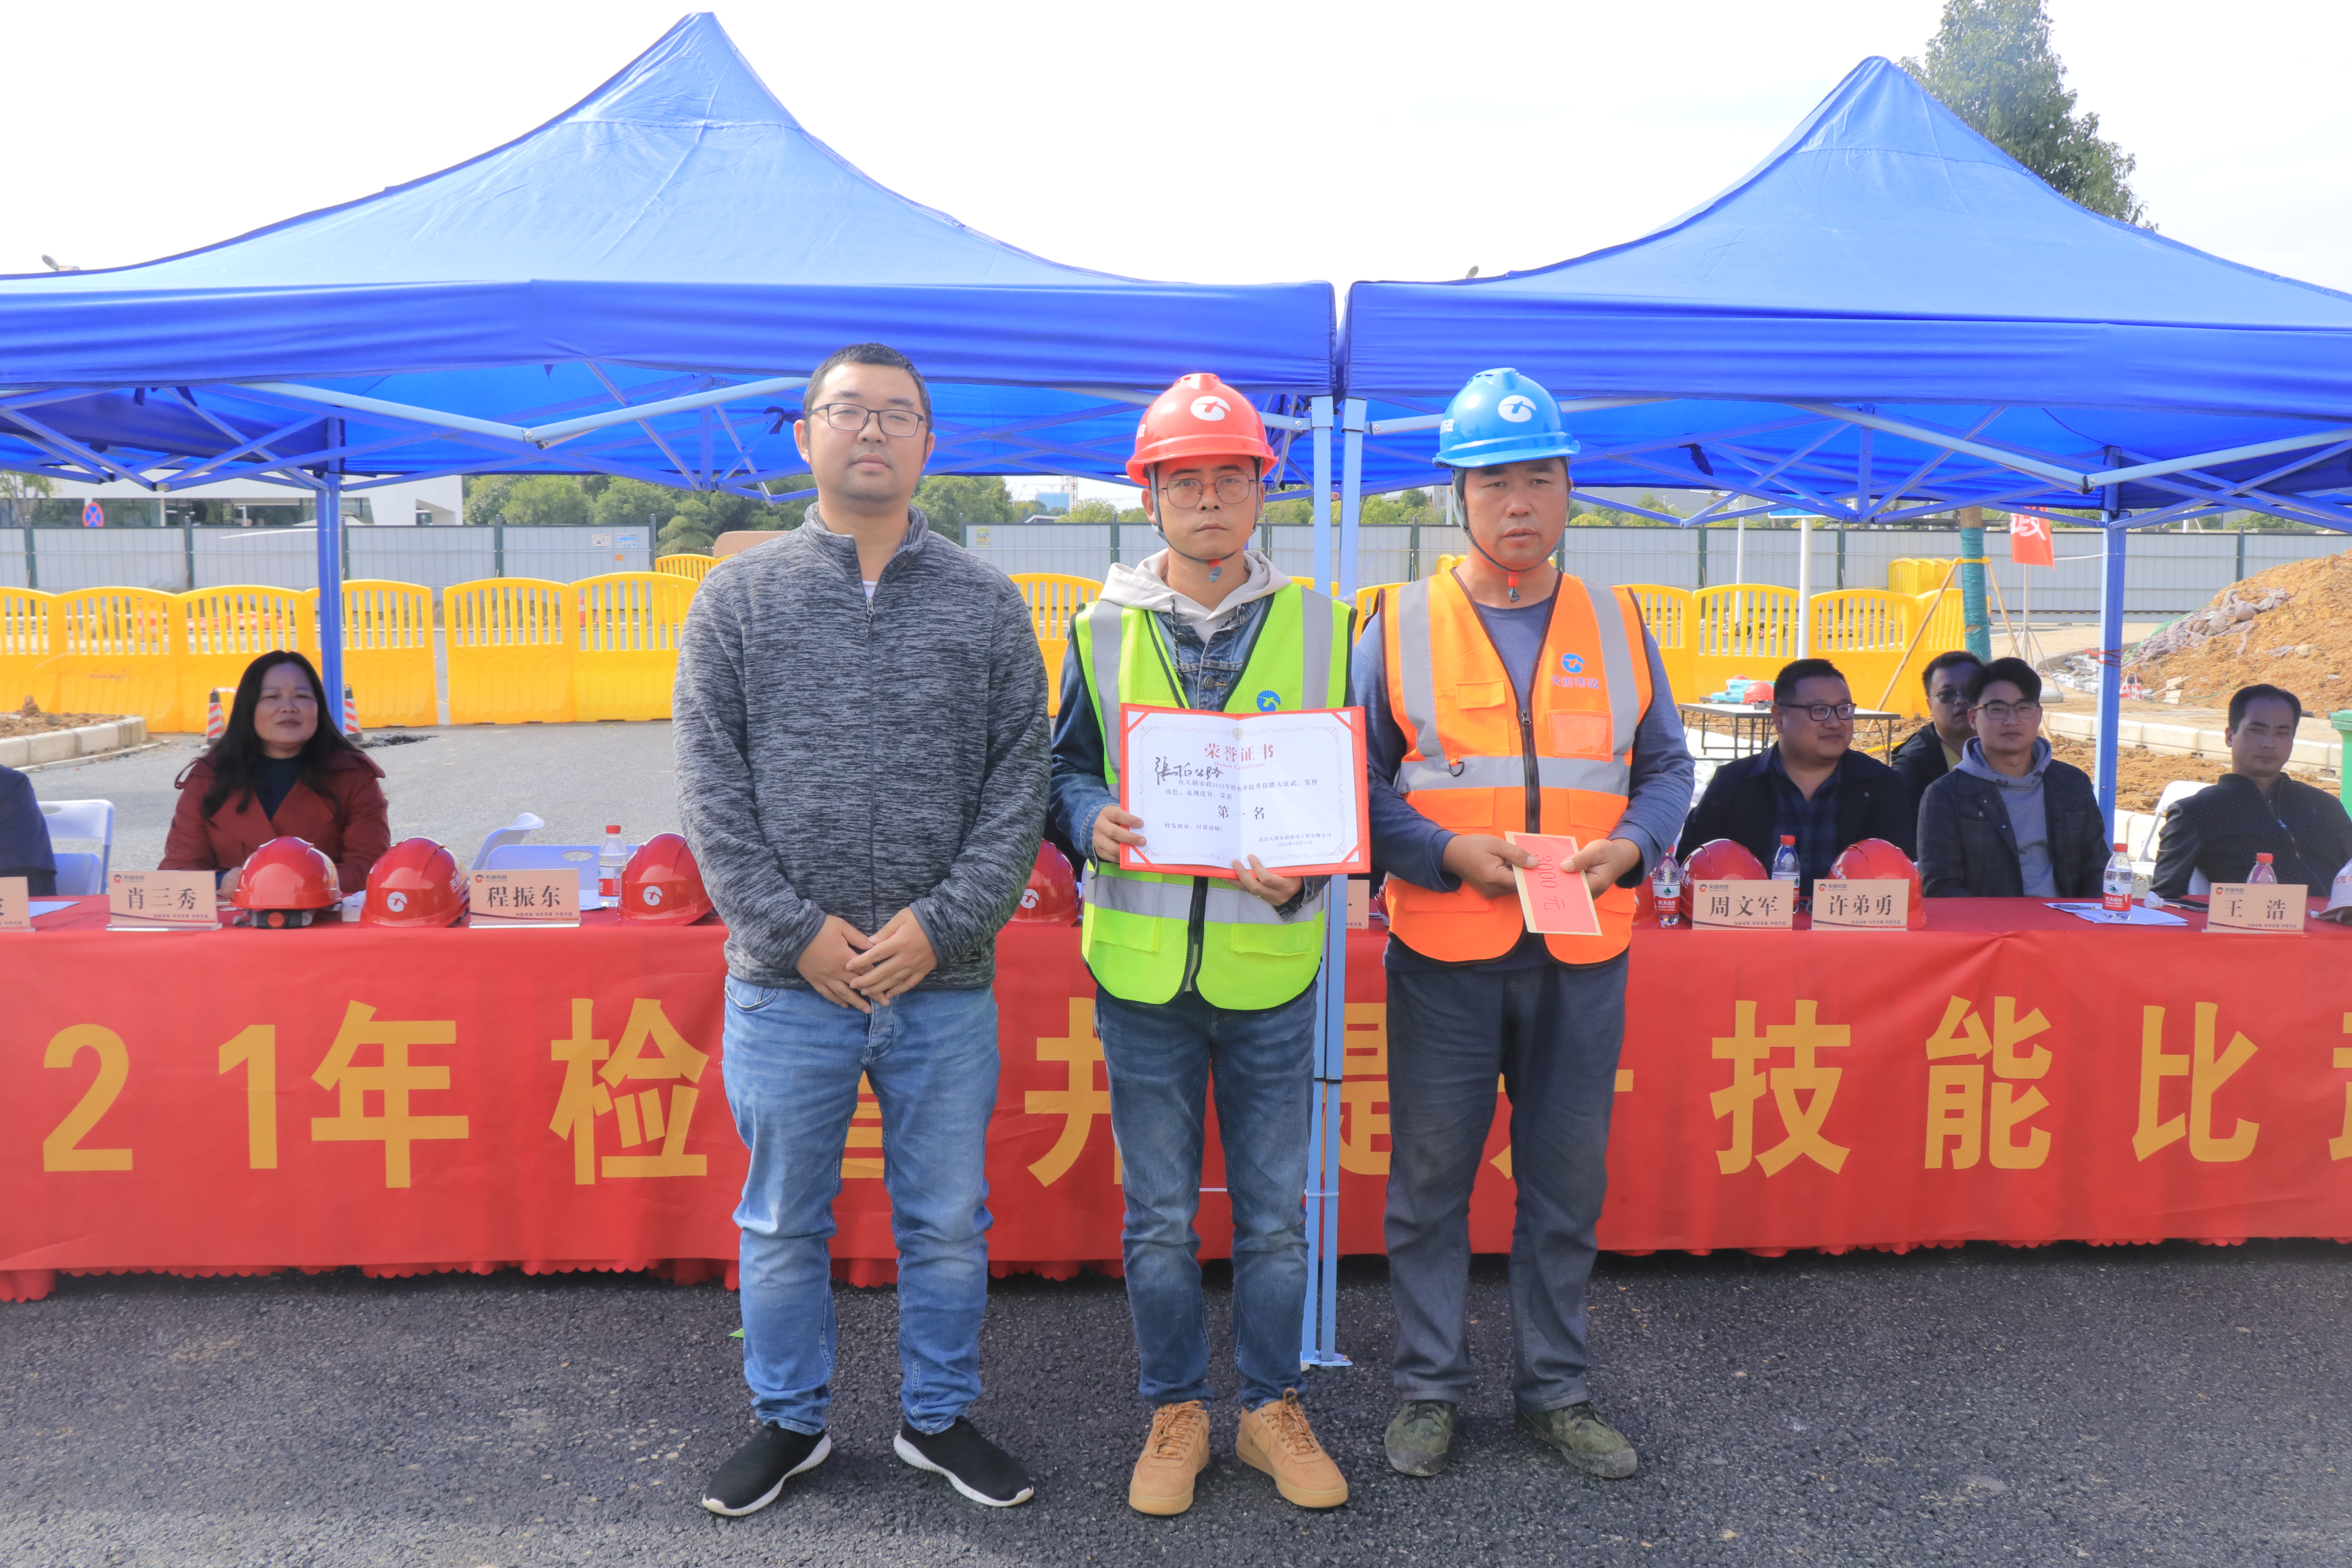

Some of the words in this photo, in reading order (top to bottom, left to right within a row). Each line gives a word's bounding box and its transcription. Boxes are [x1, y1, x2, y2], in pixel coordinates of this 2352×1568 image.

[1550, 674, 1599, 689] 天创市政
[1204, 743, 1274, 762] 荣誉证书
[1218, 805, 1264, 820] 第一名
[1259, 833, 1331, 842] 武汉天创市政建设工程有限公司
[127, 887, 196, 909] 肖三秀
[486, 885, 560, 908] 程振东
[1710, 896, 1778, 917] 周文军
[1828, 895, 1892, 916] 许弟勇
[2223, 899, 2286, 920] 王浩
